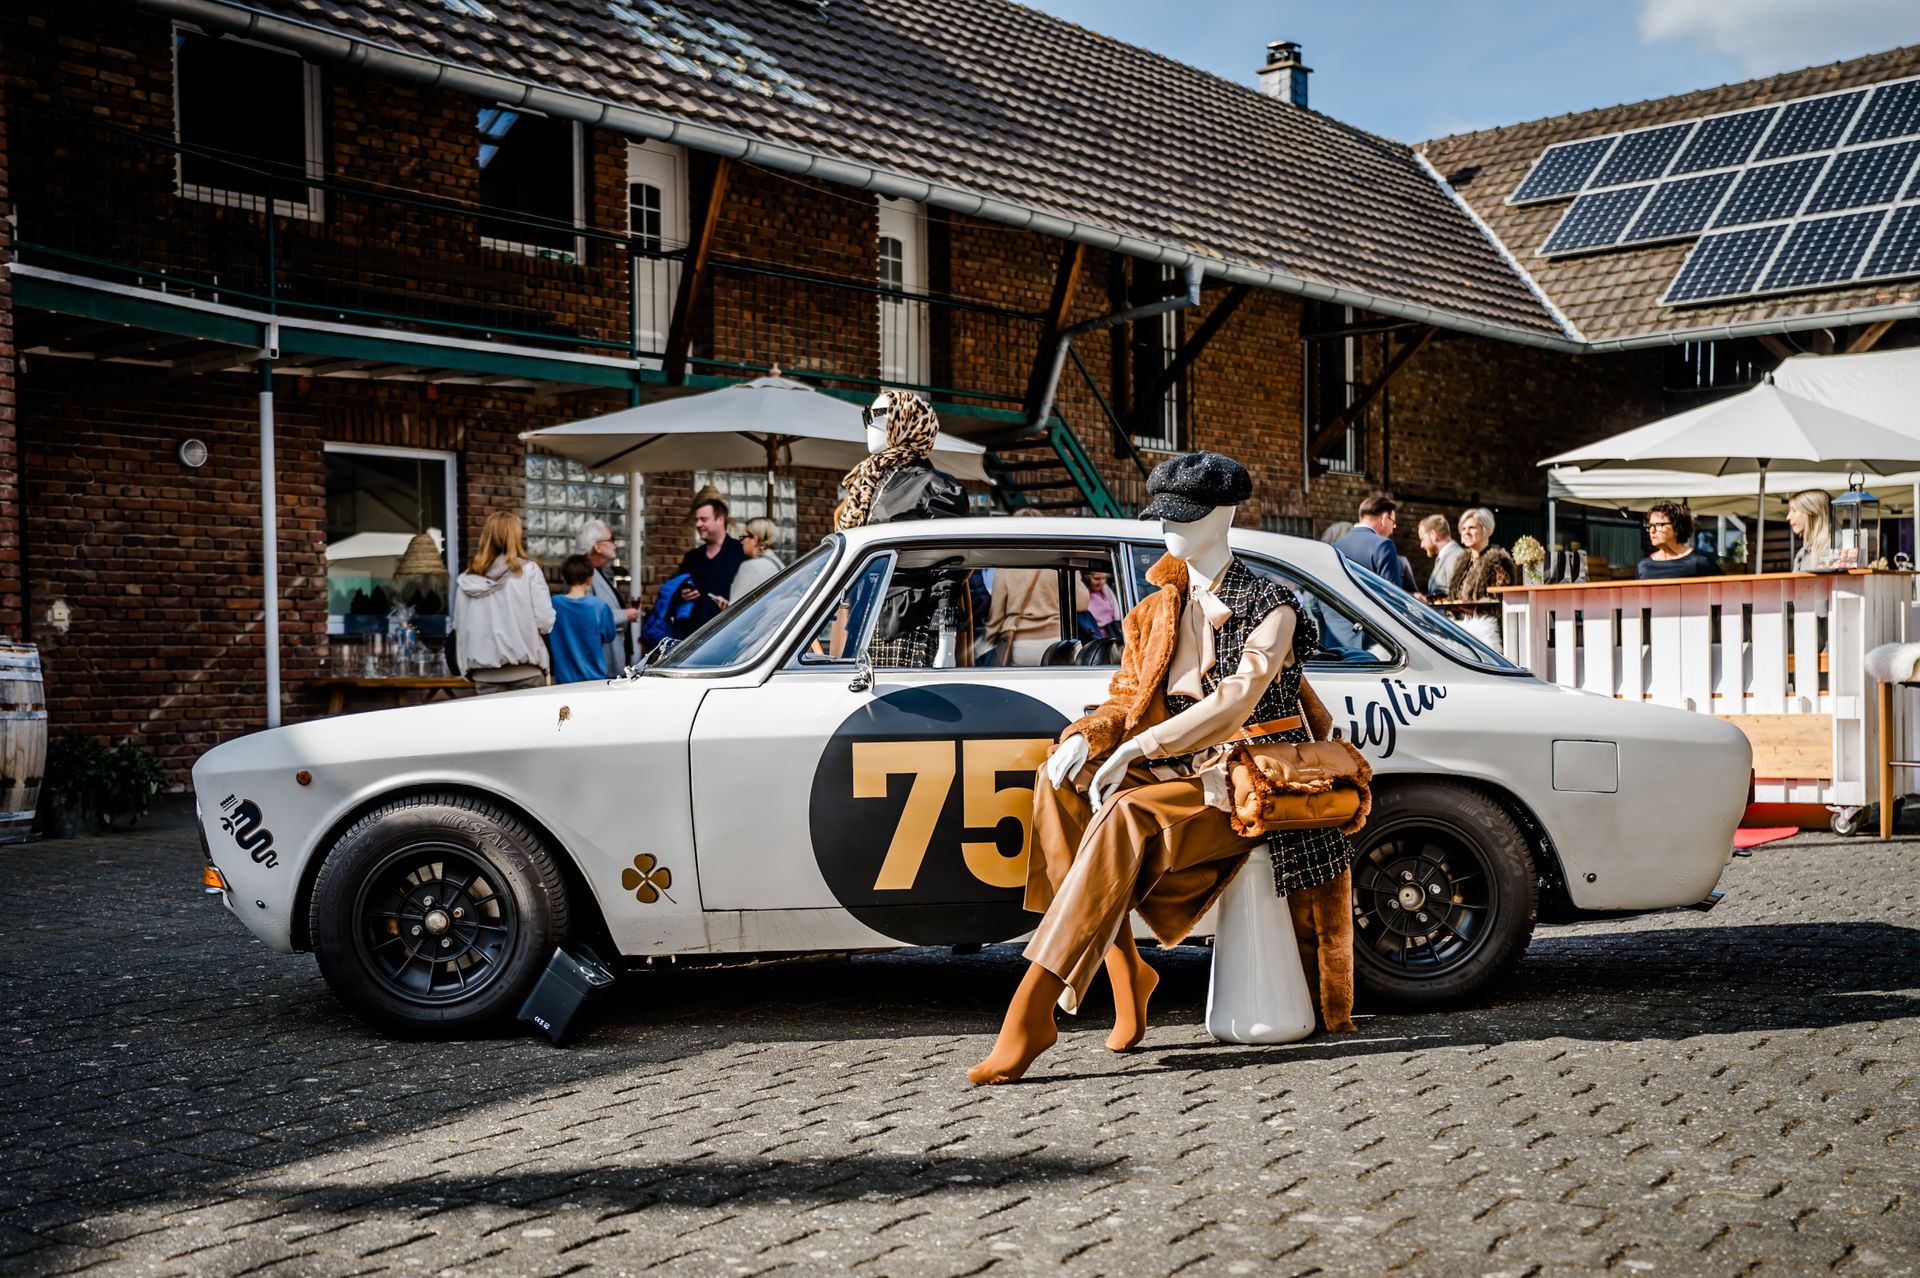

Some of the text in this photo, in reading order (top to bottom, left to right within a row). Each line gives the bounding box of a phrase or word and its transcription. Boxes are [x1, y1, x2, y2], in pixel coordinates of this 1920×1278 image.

[1332, 678, 1446, 758] iglia
[468, 822, 526, 872] SAVA
[852, 739, 1054, 890] 75
